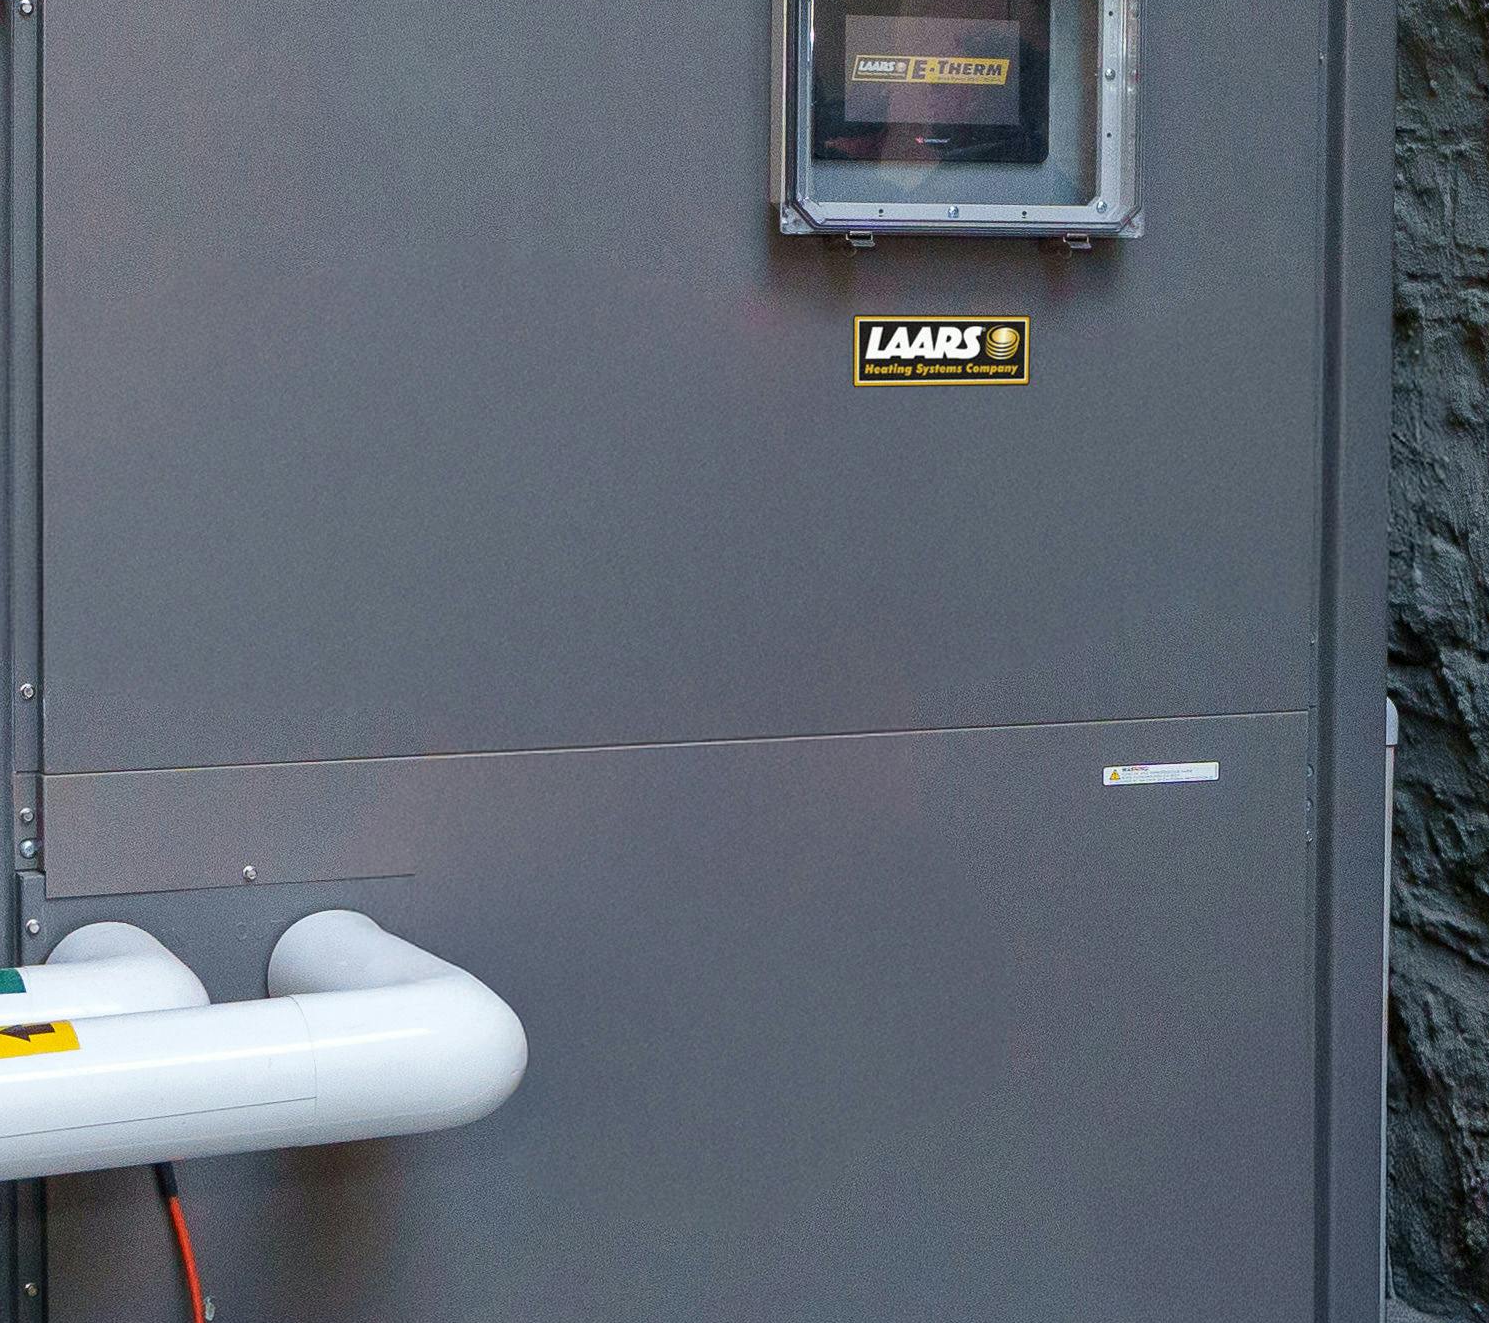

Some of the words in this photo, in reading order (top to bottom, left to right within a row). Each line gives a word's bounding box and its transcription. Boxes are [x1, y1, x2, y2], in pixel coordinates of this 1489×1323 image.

[865, 326, 983, 360] LAARS
[864, 363, 912, 376] Heating
[915, 363, 962, 376] Systems
[965, 363, 1019, 375] Company
